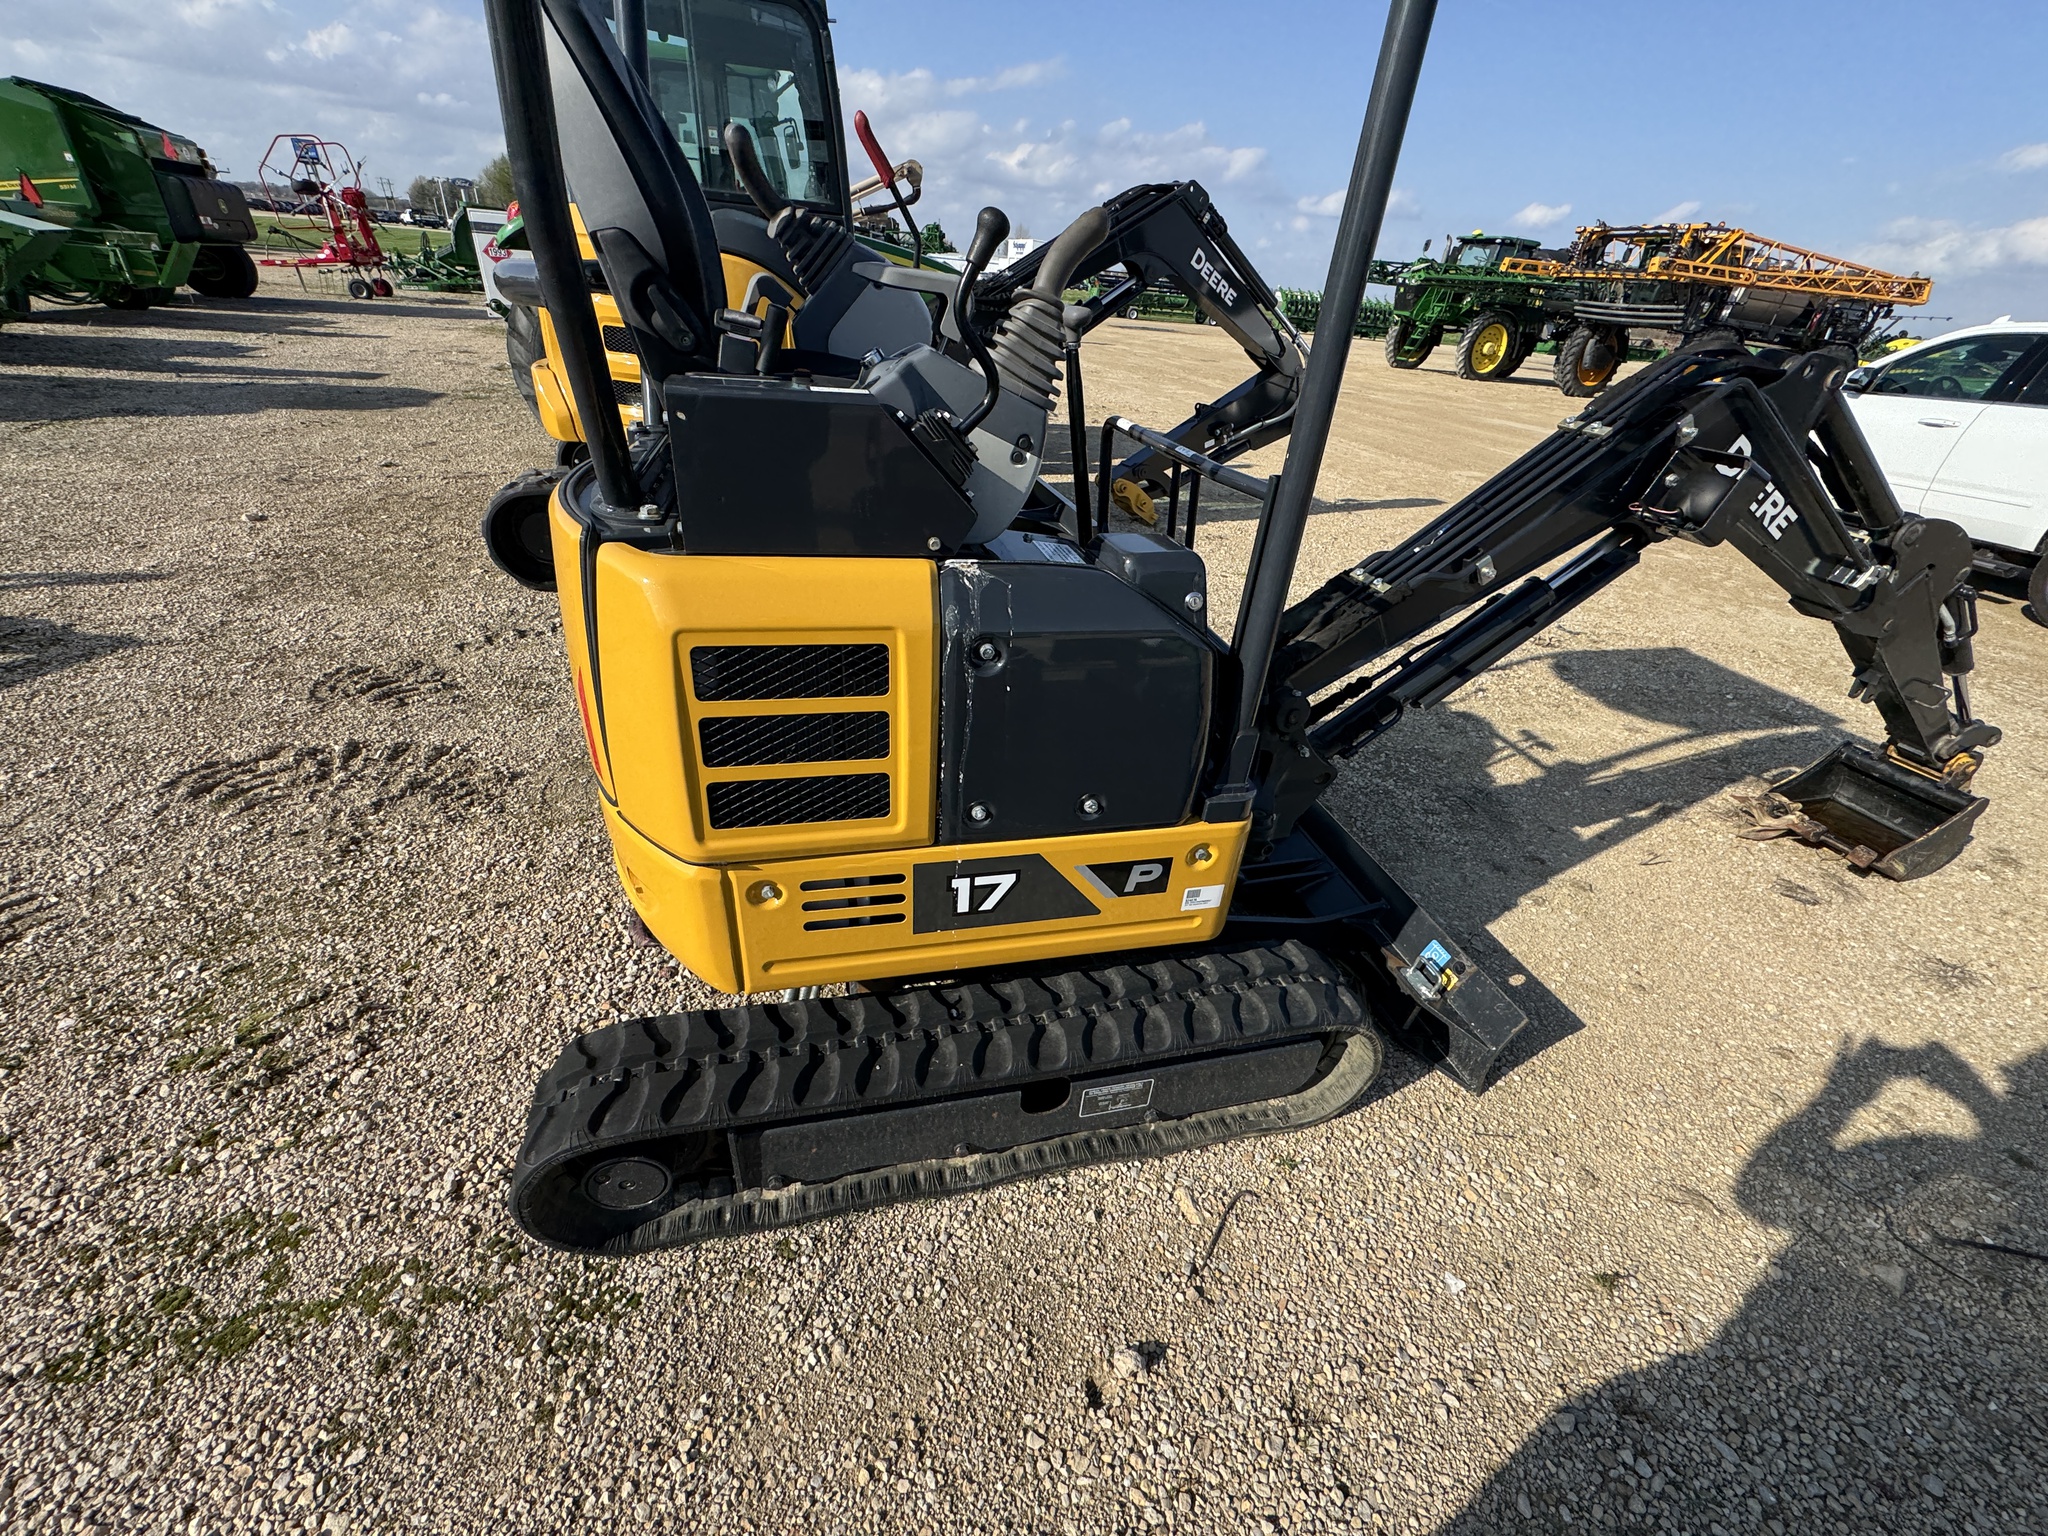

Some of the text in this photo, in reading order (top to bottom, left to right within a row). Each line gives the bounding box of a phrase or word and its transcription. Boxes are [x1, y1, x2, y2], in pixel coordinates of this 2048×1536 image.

[489, 247, 507, 257] 1993
[1190, 247, 1238, 307] DEERE
[1714, 434, 1799, 541] DRE
[951, 863, 1163, 914] 17 P
